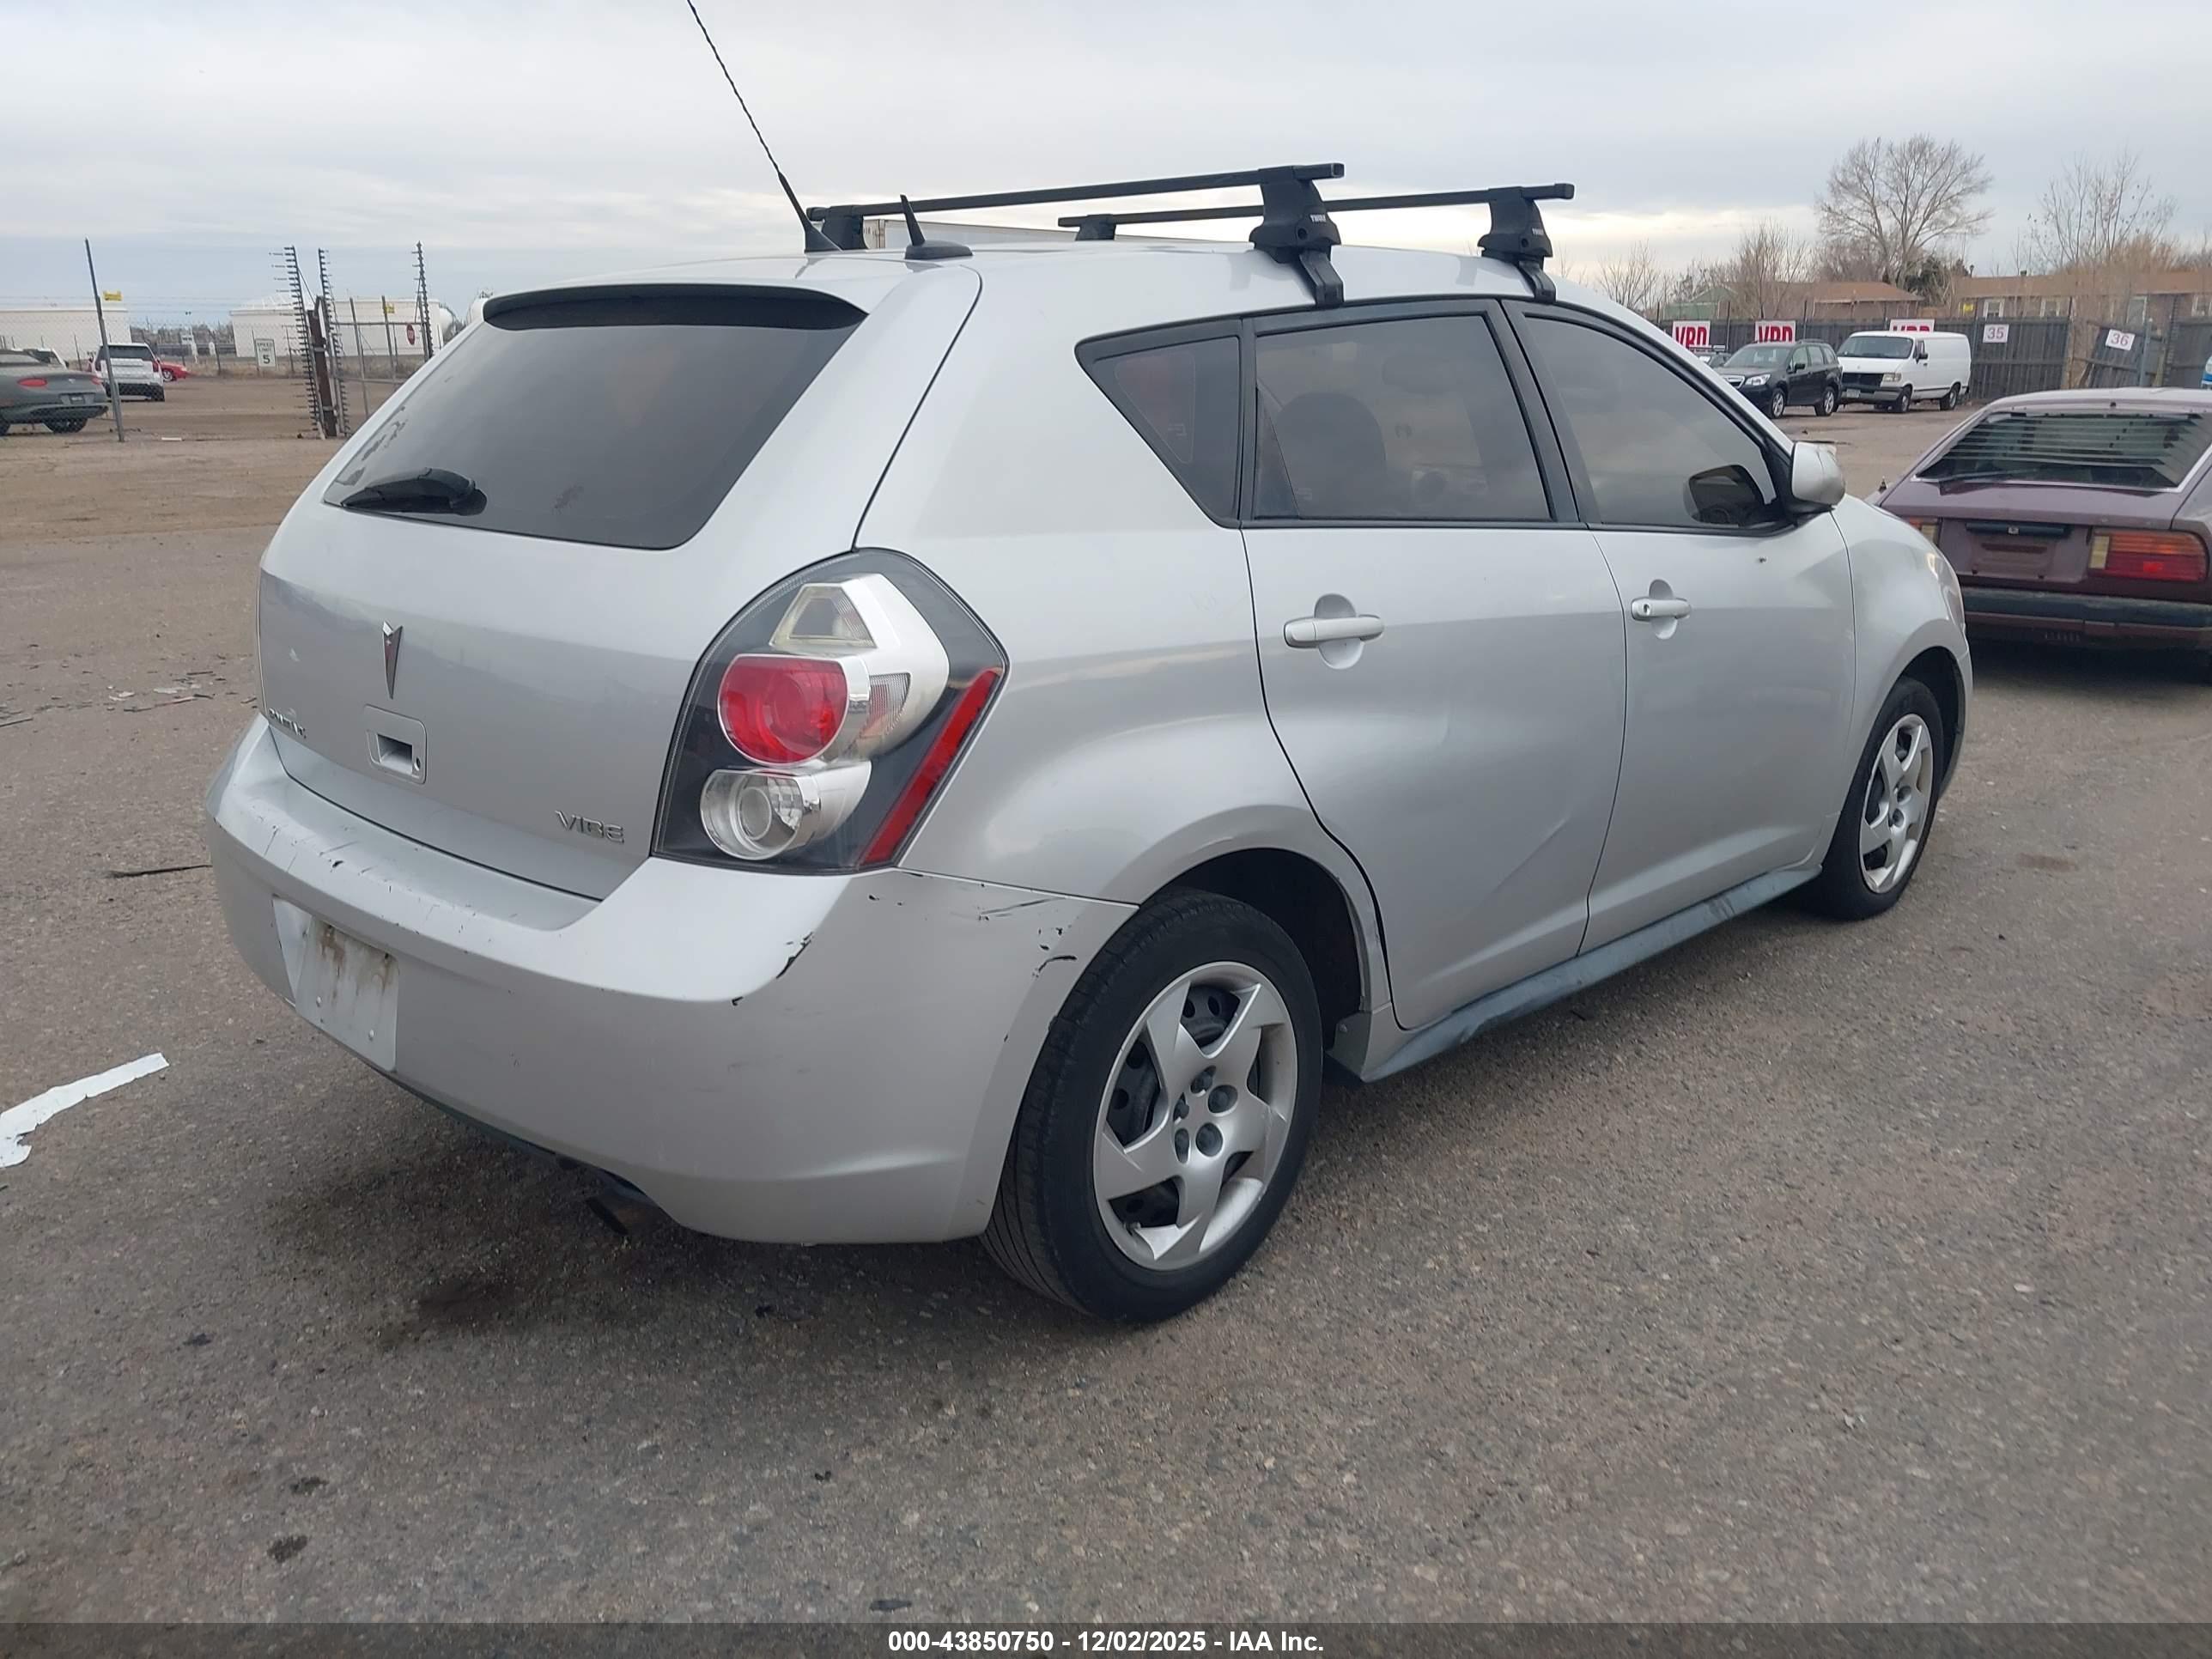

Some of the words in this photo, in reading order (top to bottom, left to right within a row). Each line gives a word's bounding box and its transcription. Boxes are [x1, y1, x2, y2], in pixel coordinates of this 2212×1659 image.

[1987, 327, 2004, 339] 35
[2111, 332, 2129, 347] 36
[263, 354, 270, 364] 5
[555, 810, 625, 844] VIBE
